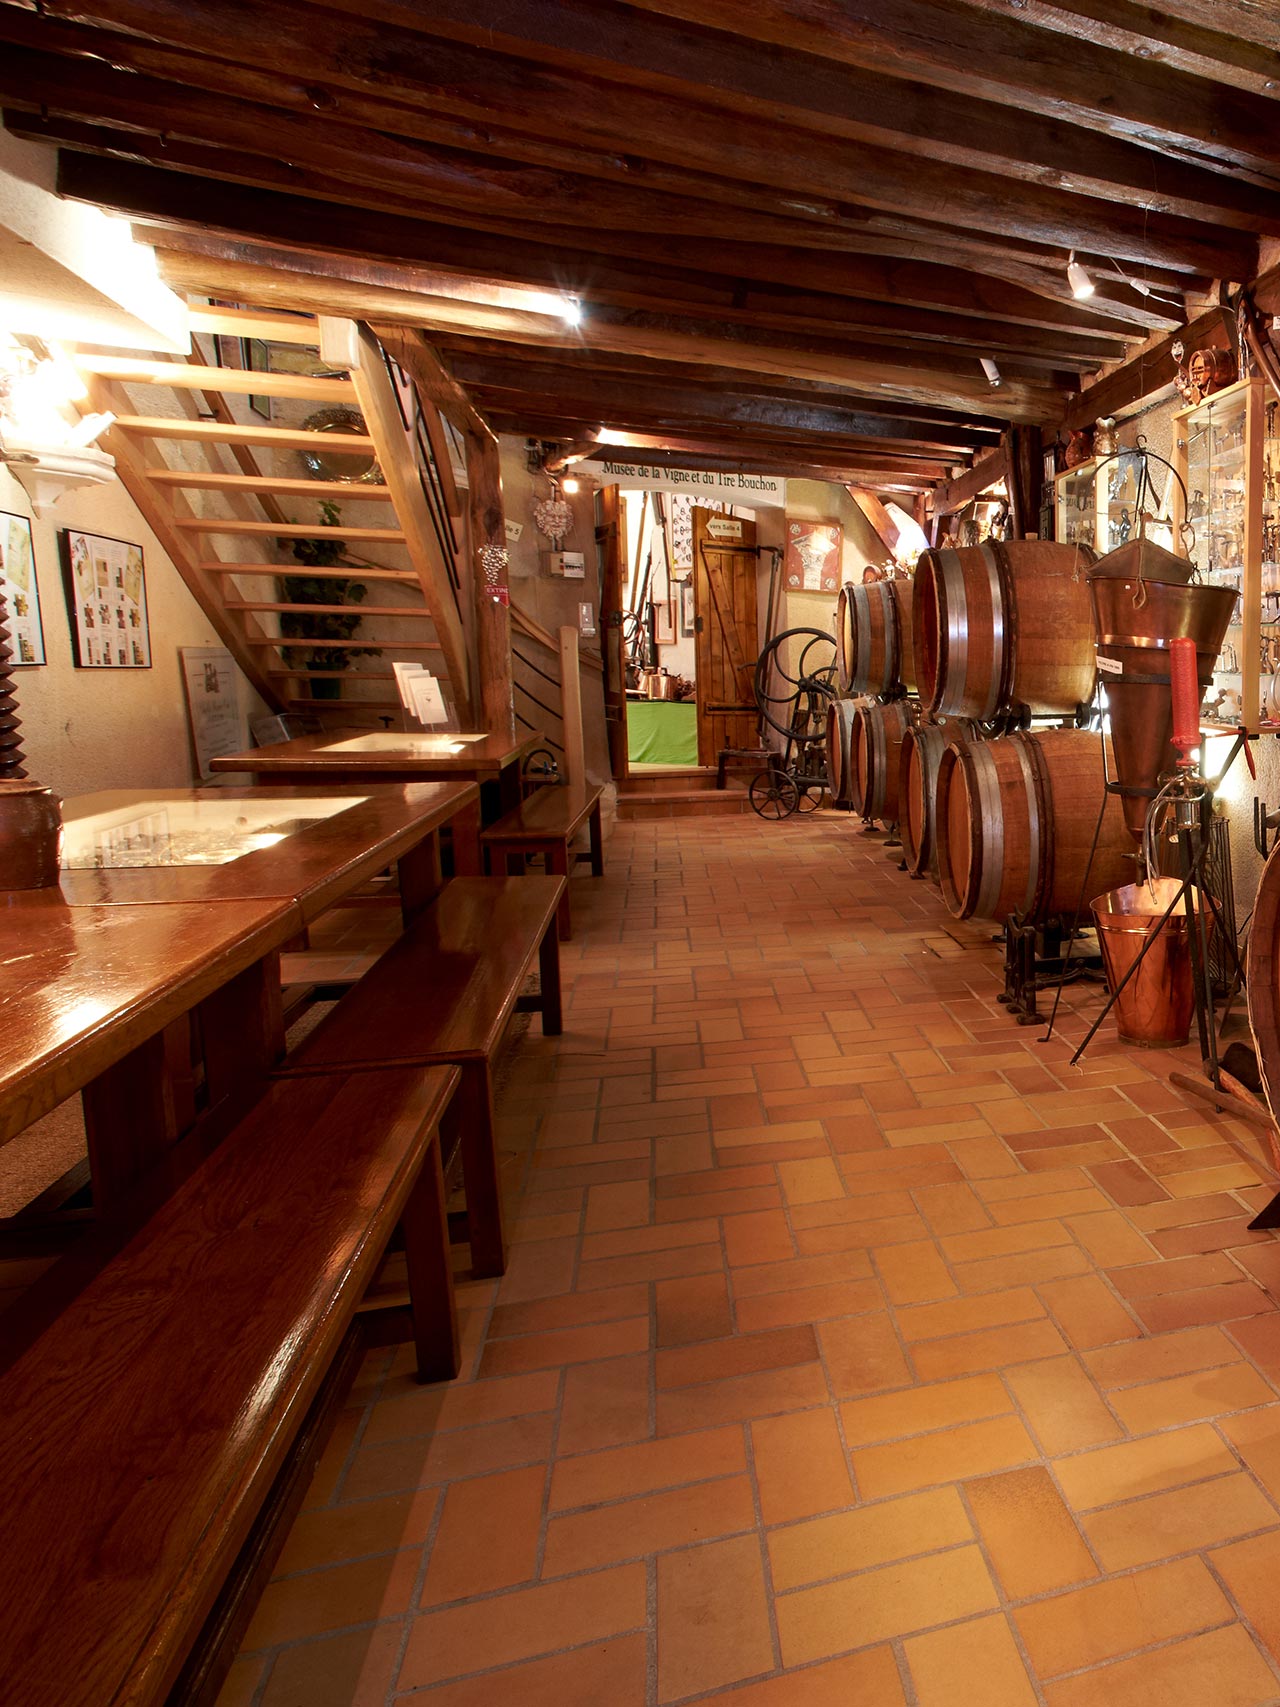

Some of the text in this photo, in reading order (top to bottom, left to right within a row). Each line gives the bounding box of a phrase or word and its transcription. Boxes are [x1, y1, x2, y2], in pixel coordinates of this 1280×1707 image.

[638, 465, 650, 478] de
[652, 466, 661, 479] la
[663, 467, 690, 484] Vigne
[691, 471, 701, 484] et
[702, 471, 715, 485] du
[717, 473, 736, 488] Tire
[737, 473, 778, 492] Bouchon
[514, 527, 521, 535] 5
